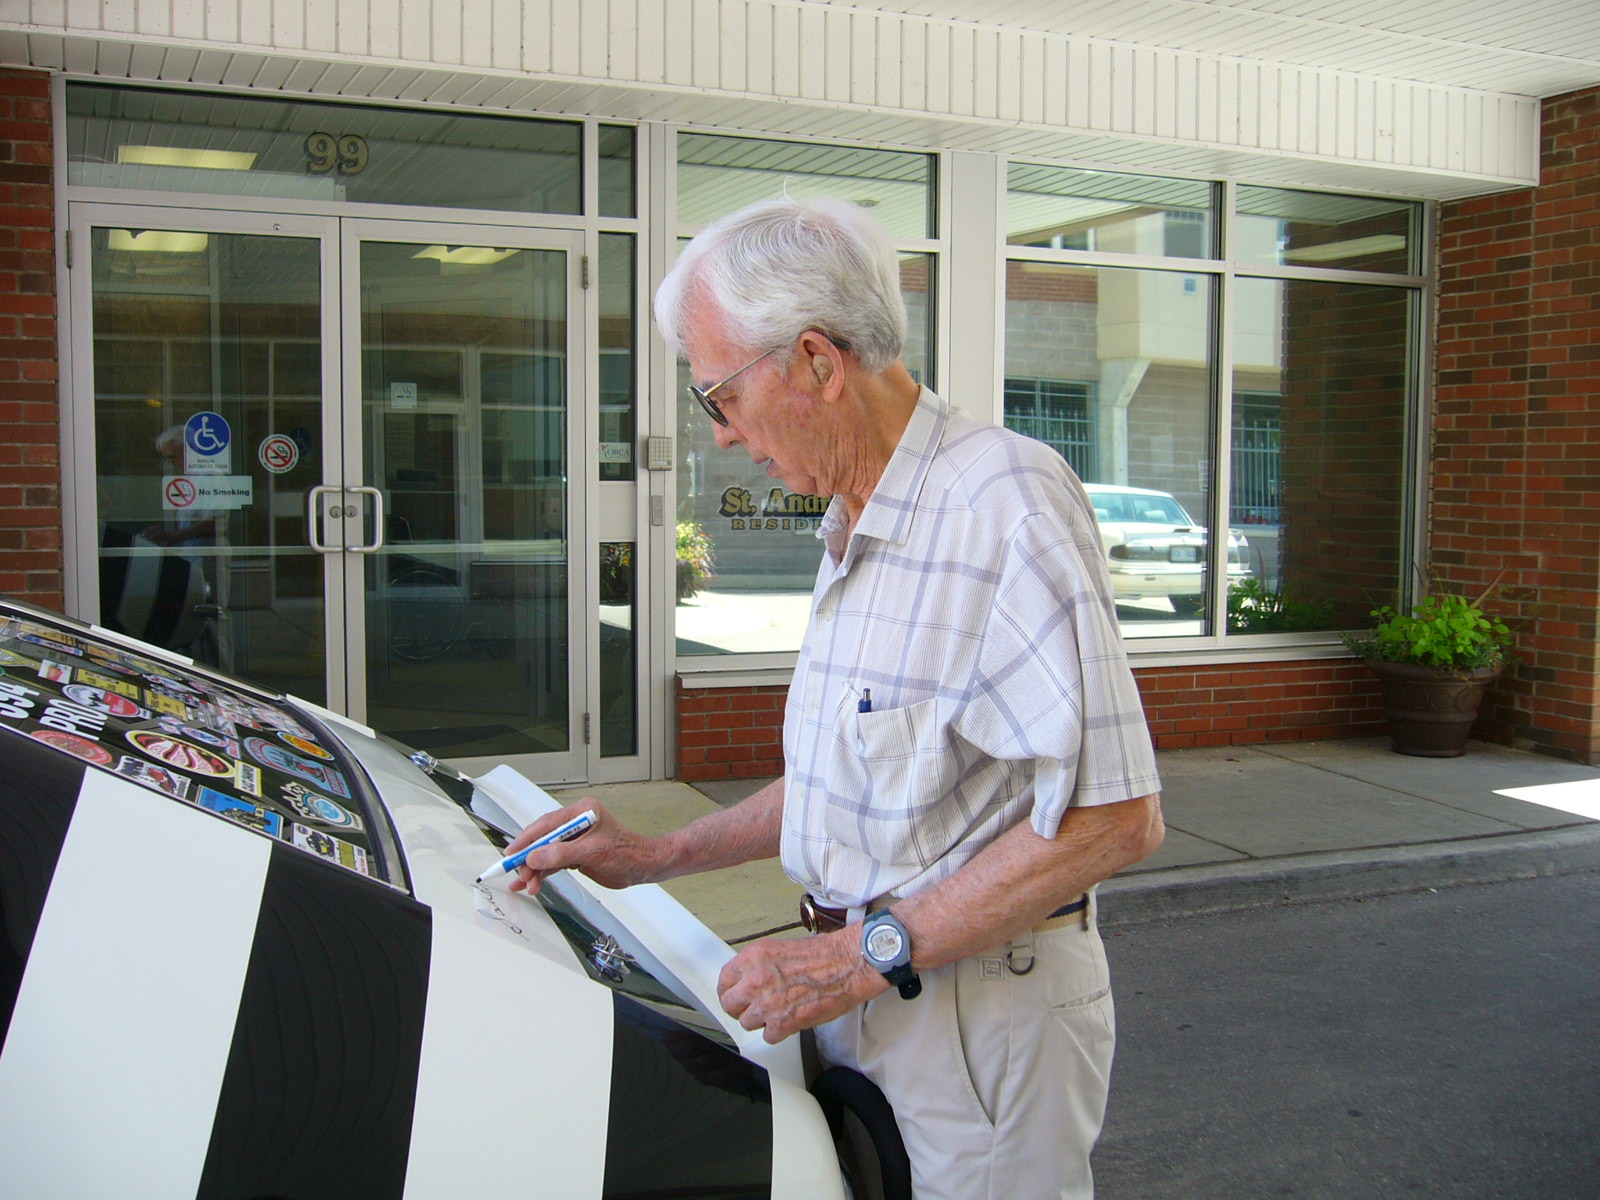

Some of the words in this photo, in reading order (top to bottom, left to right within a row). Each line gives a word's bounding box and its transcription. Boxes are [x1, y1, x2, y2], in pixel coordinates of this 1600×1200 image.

[304, 132, 369, 175] 99
[198, 488, 211, 496] No
[212, 488, 250, 497] Smoking
[718, 486, 757, 517] St.
[762, 487, 831, 517] Andr
[731, 519, 823, 530] RESIDE
[40, 699, 108, 741] PRO
